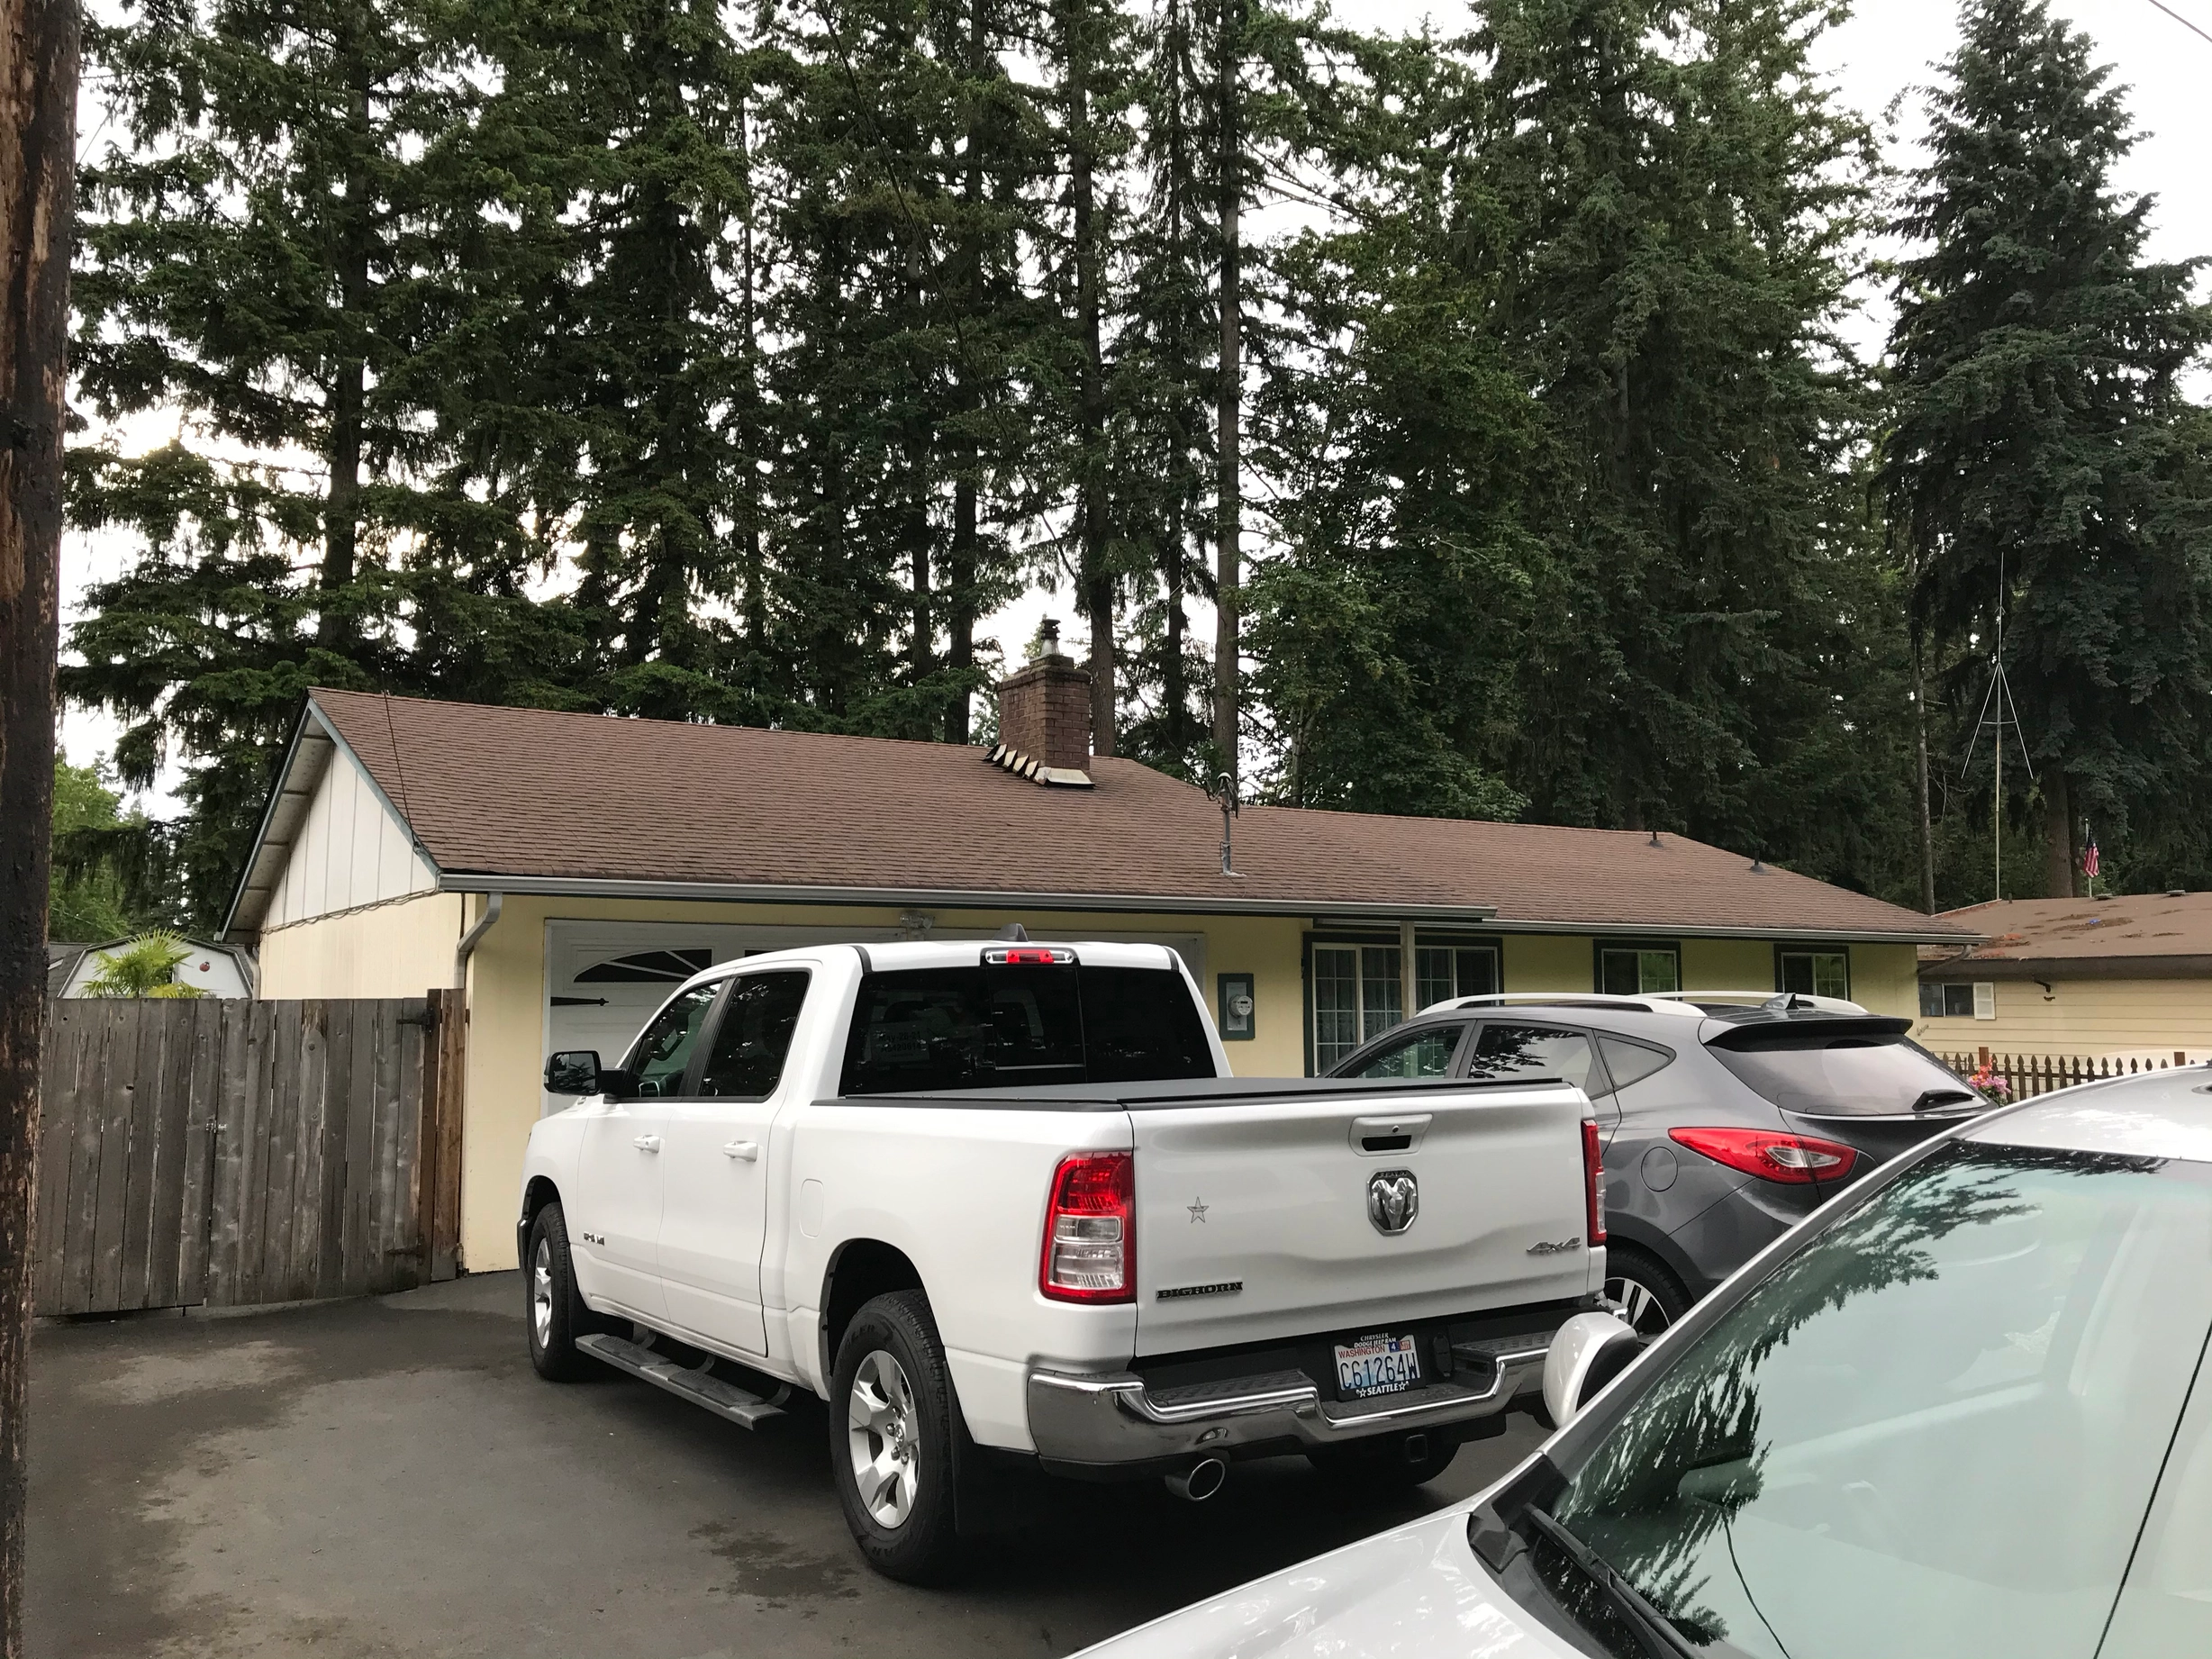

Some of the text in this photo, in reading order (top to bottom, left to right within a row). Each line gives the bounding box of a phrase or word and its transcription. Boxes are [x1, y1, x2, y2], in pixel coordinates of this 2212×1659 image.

[1156, 1282, 1243, 1299] BIGHORN
[1354, 1340, 1373, 1348] DODGE
[1373, 1338, 1385, 1347] JEEP
[1360, 1332, 1389, 1342] CHRYSLER
[1338, 1346, 1385, 1359] WASHINGTON
[1340, 1352, 1418, 1389] C61264W
[1366, 1382, 1399, 1396] SEATTLE
